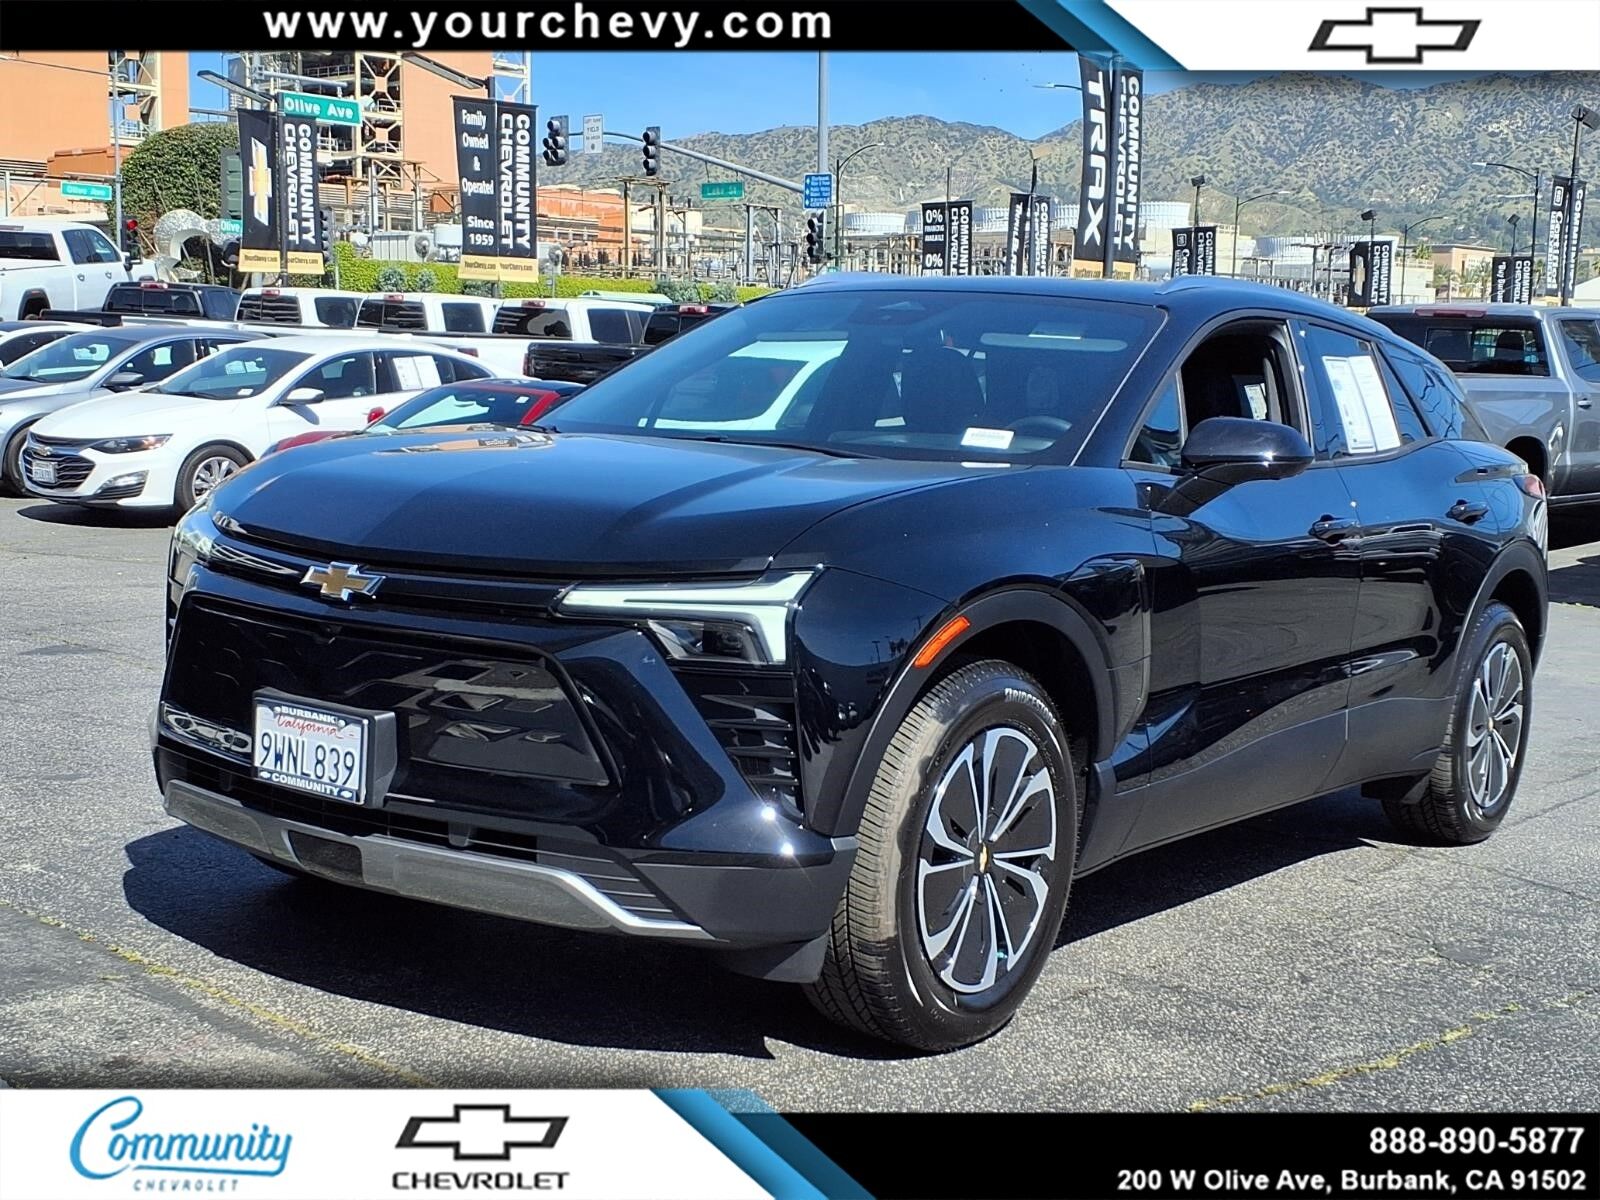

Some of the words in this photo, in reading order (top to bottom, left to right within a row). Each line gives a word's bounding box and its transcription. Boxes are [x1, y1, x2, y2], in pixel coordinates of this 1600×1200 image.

[284, 97, 321, 115] Olive
[327, 103, 354, 119] Ave
[461, 109, 487, 130] Family
[462, 132, 490, 150] Owned
[1083, 71, 1107, 247] TRAX
[1113, 75, 1127, 250] CHEVROLET
[284, 123, 299, 245] CHEVROLET
[298, 123, 317, 245] COMMUNITY
[473, 155, 481, 172] &
[501, 113, 513, 249] CHEVROLET
[516, 114, 531, 249] COMMUNITY
[1124, 76, 1140, 250] COMMUNITY
[461, 177, 495, 197] Operated
[220, 219, 241, 234] Olive
[467, 215, 495, 230] Since
[925, 209, 943, 225] 0%
[287, 256, 319, 265] ourChevy.com
[468, 233, 494, 246] 1959
[925, 252, 943, 268] 0%
[951, 207, 959, 276] CHEVROLE
[960, 206, 969, 276] COMMUNIT
[1040, 202, 1049, 276] COMMUNIT
[1197, 232, 1205, 275] CHEVRO
[1205, 231, 1214, 275] COMMU
[1379, 244, 1390, 304] COMMUNITY
[1521, 260, 1531, 304] COMMUNIT
[276, 714, 344, 740] California
[281, 705, 336, 724] BURBANK
[260, 732, 355, 786] 9WNL839
[271, 772, 340, 797] COMMUNITY
